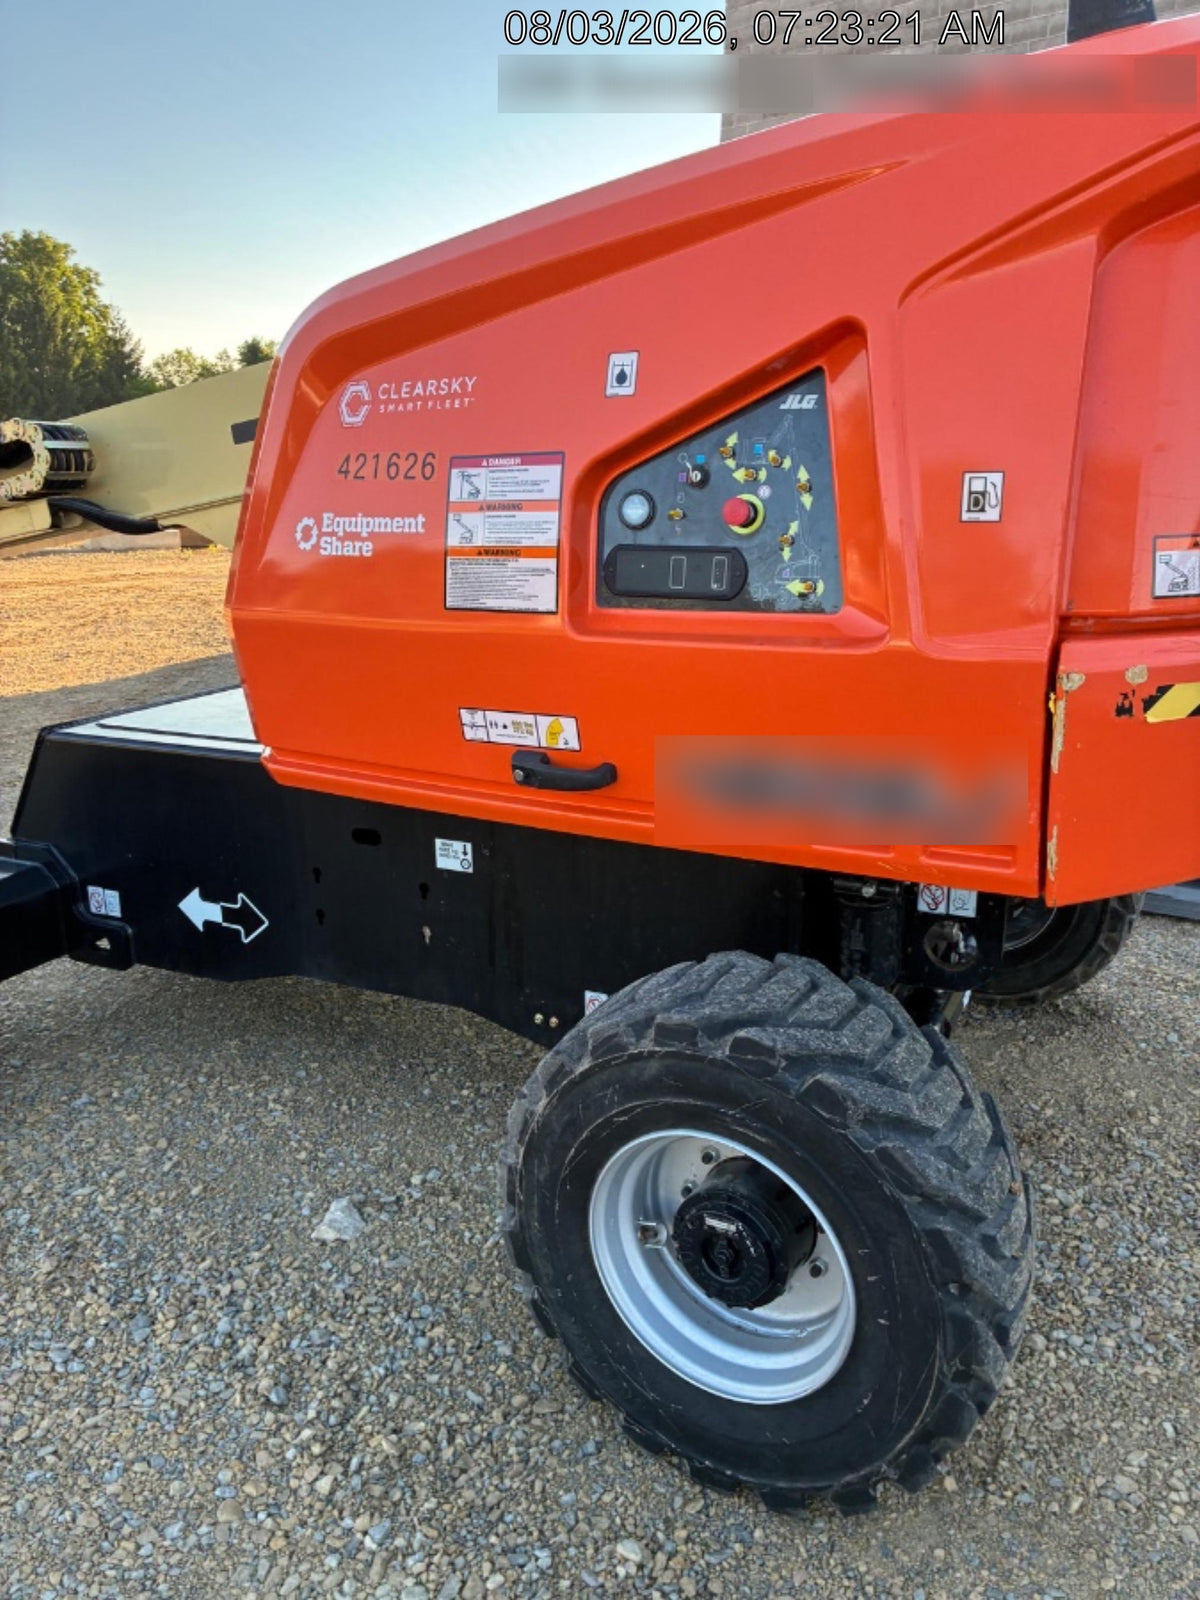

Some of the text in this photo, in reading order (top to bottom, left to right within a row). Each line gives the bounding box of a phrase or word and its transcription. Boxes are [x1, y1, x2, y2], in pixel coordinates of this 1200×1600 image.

[378, 376, 477, 400] CLEARSKY
[379, 401, 422, 413] SMART
[779, 394, 818, 410] JLG
[337, 452, 436, 481] 421626
[488, 456, 522, 467] DANGER
[485, 502, 523, 512] WARNING
[321, 512, 426, 538] Equipment
[319, 536, 373, 557] Share
[482, 548, 522, 557] WARNING
